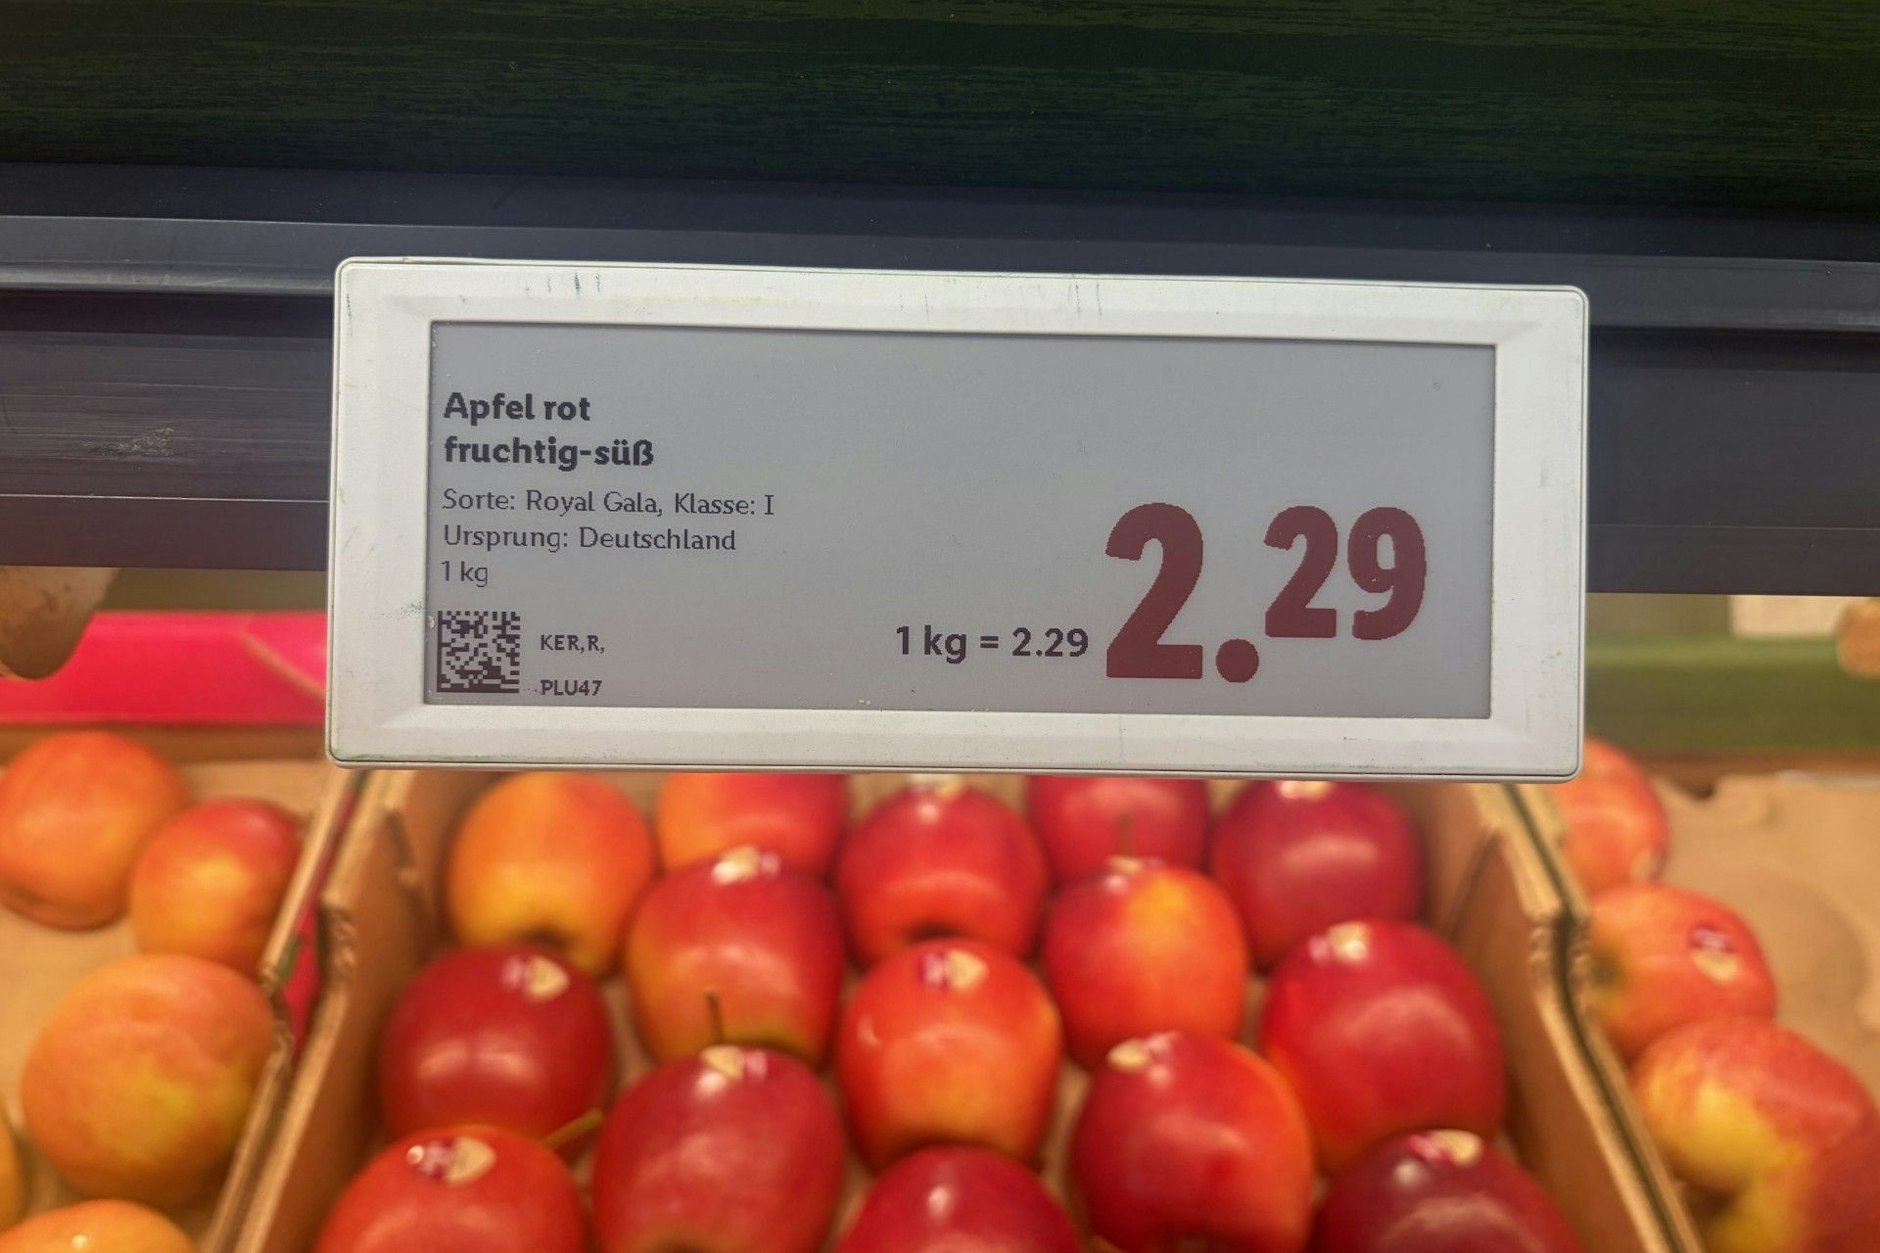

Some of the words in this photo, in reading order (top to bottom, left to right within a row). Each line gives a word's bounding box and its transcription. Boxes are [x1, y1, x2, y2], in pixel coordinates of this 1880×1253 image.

[443, 391, 535, 426] Apfel
[544, 397, 591, 421] rot
[445, 435, 655, 472] fruchtig-süß
[442, 488, 516, 510] Sorte:
[526, 489, 595, 517] Royal
[603, 490, 664, 517] Gala,
[675, 492, 756, 515] Klasse:
[764, 494, 775, 516] I
[443, 524, 569, 552] Ursprung:
[579, 526, 736, 551] Deutschland
[441, 561, 451, 582] 1
[460, 561, 489, 588] kg
[896, 625, 909, 656] 1
[923, 626, 967, 664] kg
[980, 635, 1000, 650] =
[1012, 627, 1089, 658] 2.29
[541, 679, 603, 697] PLU47
